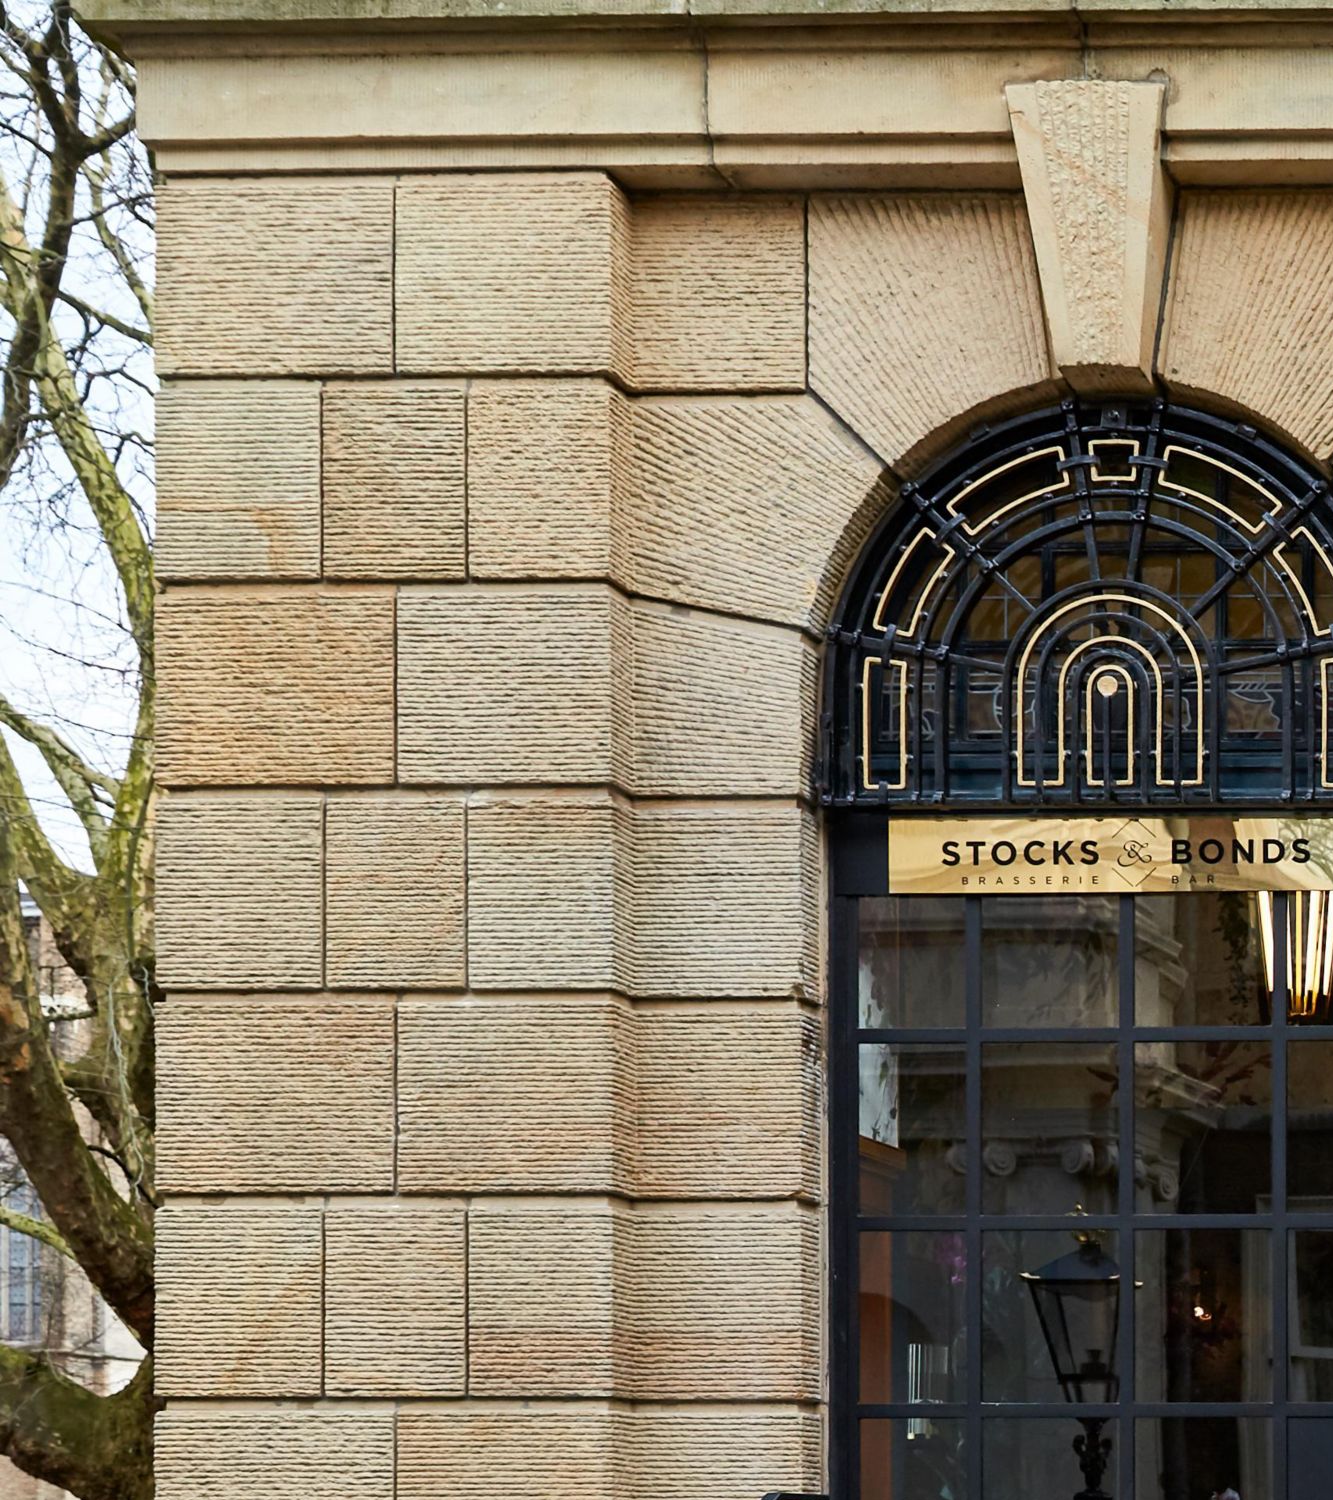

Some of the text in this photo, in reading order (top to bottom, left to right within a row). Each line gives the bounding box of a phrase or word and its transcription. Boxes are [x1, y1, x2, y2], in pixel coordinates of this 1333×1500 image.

[941, 838, 1311, 867] STOCKS & BONDS
[961, 874, 1215, 886] BRASSERIE BAR
